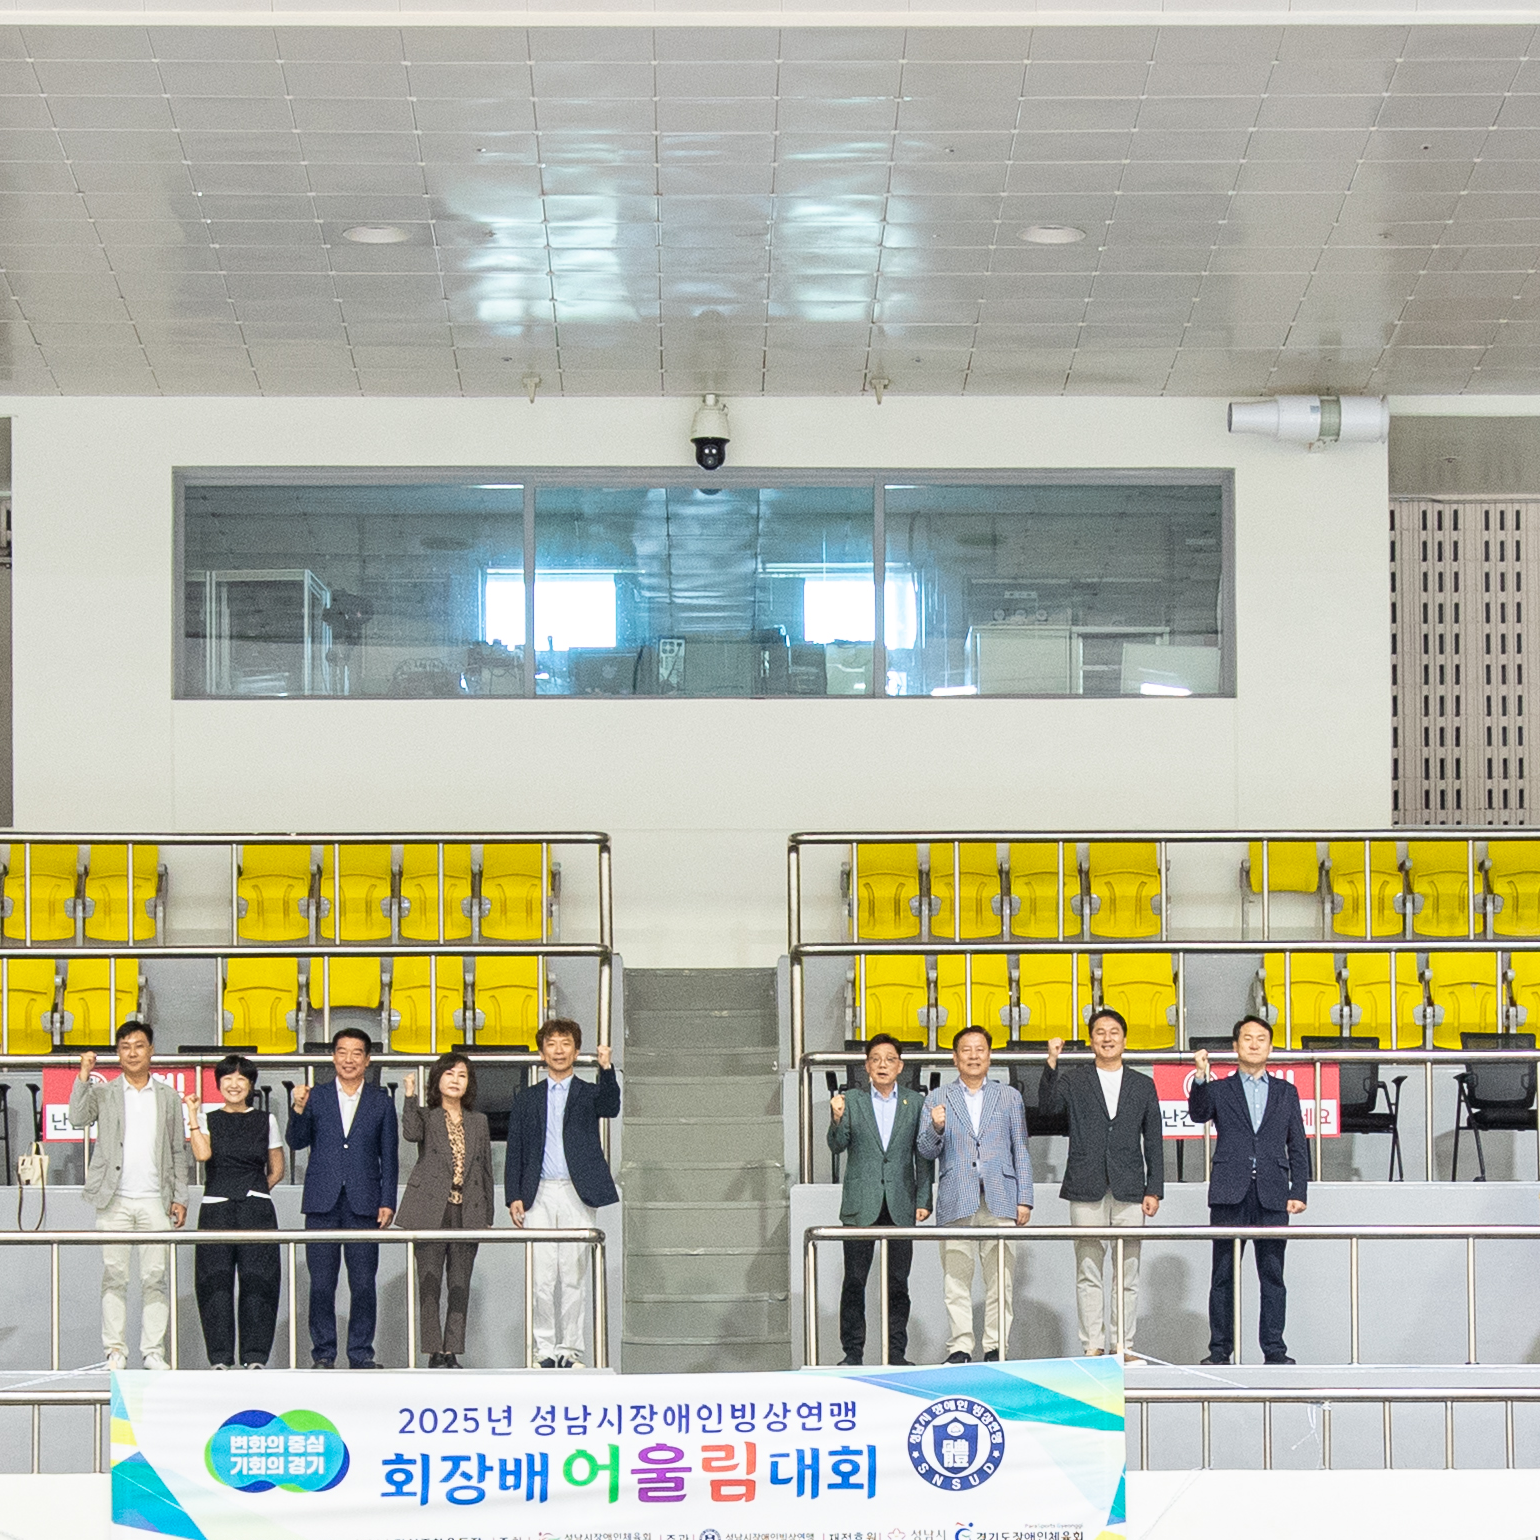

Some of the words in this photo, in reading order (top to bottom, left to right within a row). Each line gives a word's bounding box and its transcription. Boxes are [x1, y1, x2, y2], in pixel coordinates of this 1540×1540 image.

[399, 1406, 514, 1436] 2025년
[530, 1400, 857, 1436] 성남시장애인빙상연맹
[230, 1435, 284, 1454] 변화의
[288, 1435, 325, 1454] 중심
[230, 1456, 284, 1475] 기회의
[288, 1456, 325, 1475] 경기
